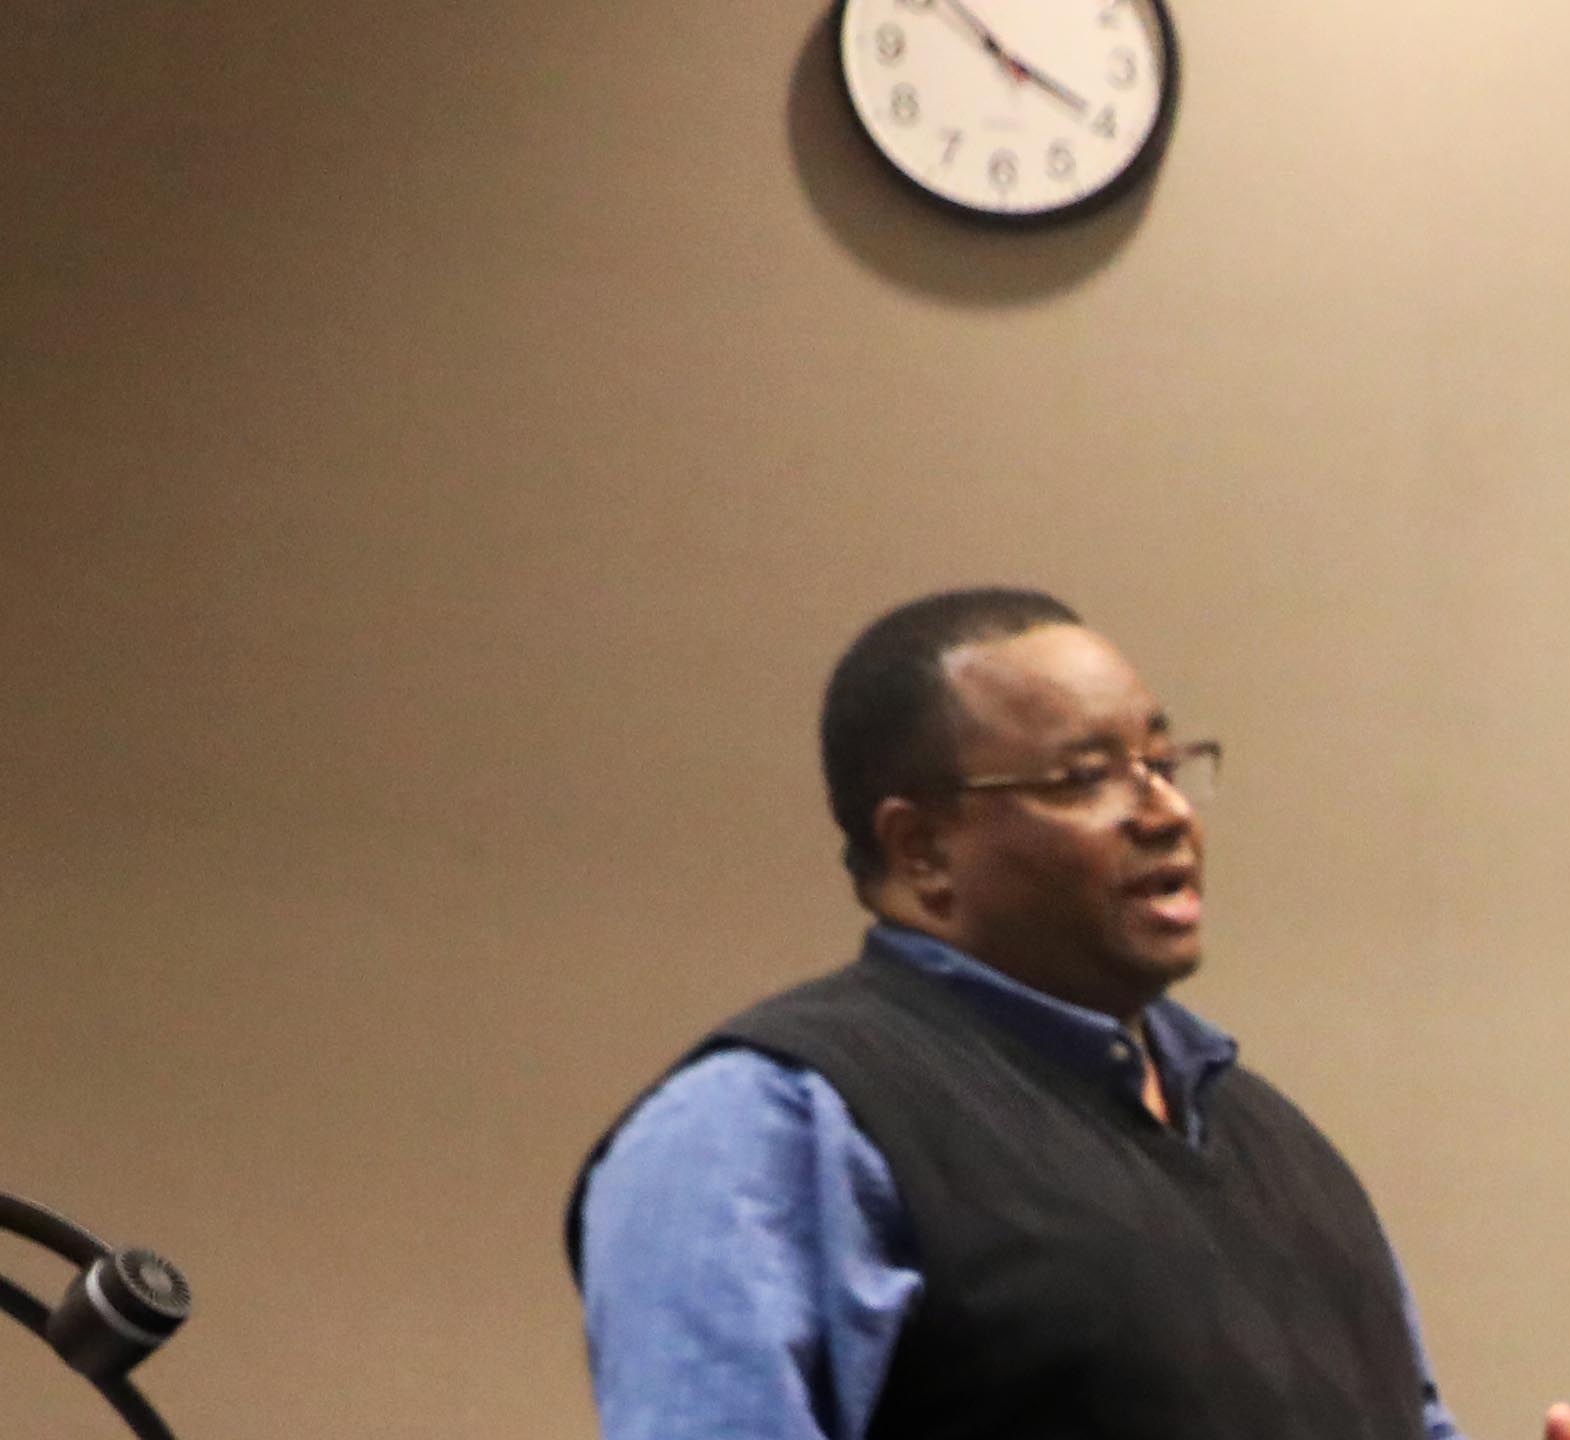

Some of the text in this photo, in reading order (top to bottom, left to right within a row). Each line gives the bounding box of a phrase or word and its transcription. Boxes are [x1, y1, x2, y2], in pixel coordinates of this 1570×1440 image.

[1093, 101, 1118, 140] 4
[940, 128, 963, 166] 7
[989, 148, 1019, 191] 6
